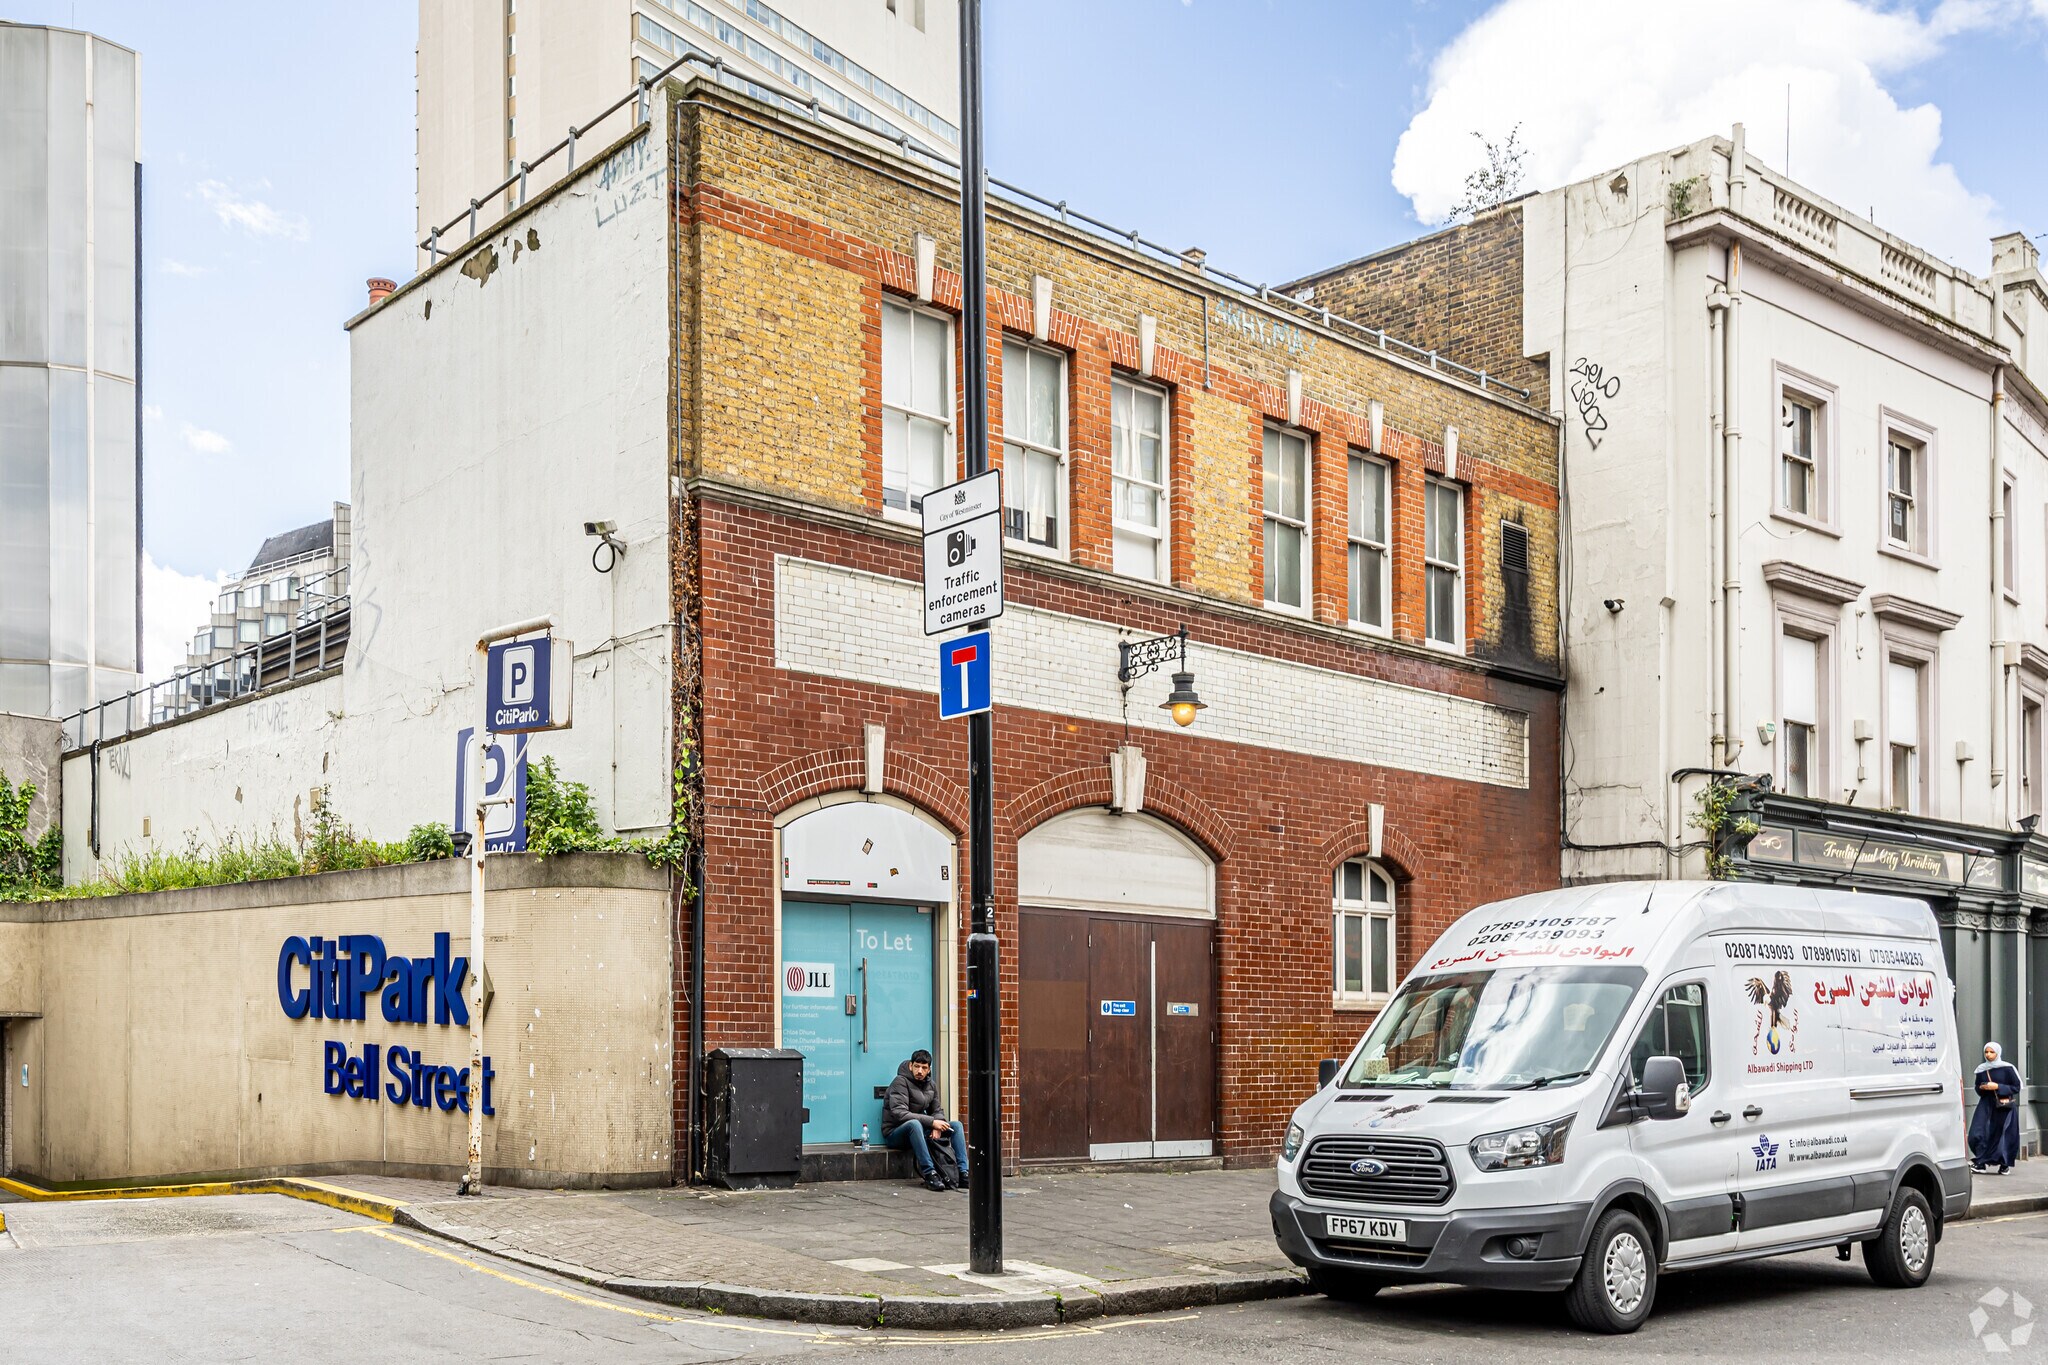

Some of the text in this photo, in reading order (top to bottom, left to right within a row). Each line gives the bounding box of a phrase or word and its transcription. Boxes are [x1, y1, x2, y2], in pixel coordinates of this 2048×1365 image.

[939, 512, 949, 522] City
[954, 502, 983, 518] Westminster
[944, 569, 980, 590] Traffic
[929, 580, 998, 611] enforcement
[940, 603, 986, 625] cameras
[511, 662, 527, 698] P
[495, 709, 535, 726] CitiPark
[1823, 840, 1941, 876] Traditional City Drinking
[986, 907, 994, 918] 2
[1478, 917, 1616, 934] 07898105787
[856, 929, 912, 951] To Let
[1467, 930, 1605, 947] 02087439093
[1725, 942, 1924, 966] 02087439093 07898105787 07985448253
[277, 932, 470, 1026] CitiPark
[806, 972, 831, 988] JLL
[1747, 1060, 1814, 1073] Albawadi Shipping LTD
[324, 1040, 496, 1116] Bell Street
[1795, 1134, 1848, 1148] info@albawadi.co.uk
[1755, 1157, 1777, 1172] IATA
[1788, 1148, 1848, 1162] W: www.albawadi.co.uk
[1355, 1161, 1375, 1173] Ford
[1332, 1218, 1398, 1238] FP67 KDV
